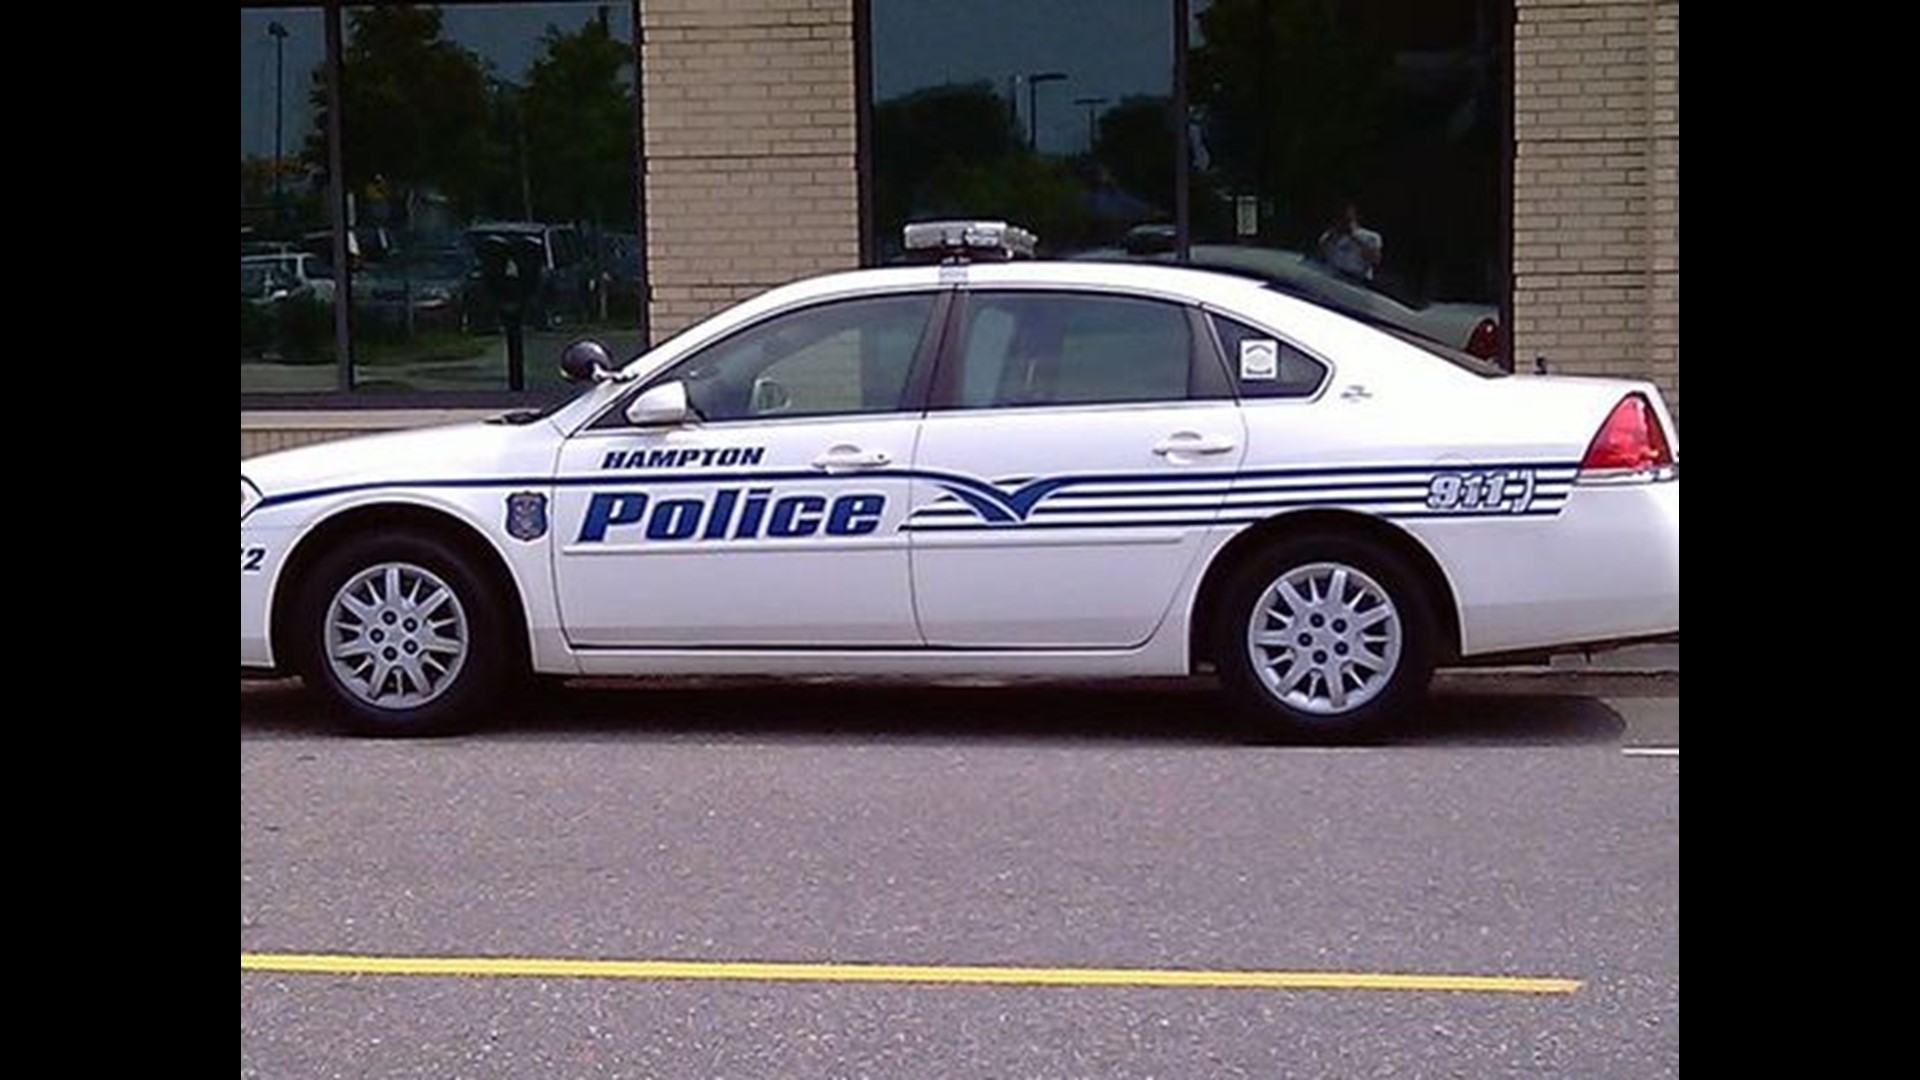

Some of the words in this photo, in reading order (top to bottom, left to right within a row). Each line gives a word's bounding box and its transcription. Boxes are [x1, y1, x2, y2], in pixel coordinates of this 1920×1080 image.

[602, 447, 765, 469] HAMPTON
[1426, 470, 1508, 509] 911
[575, 487, 886, 543] Police
[241, 548, 266, 571] 2
